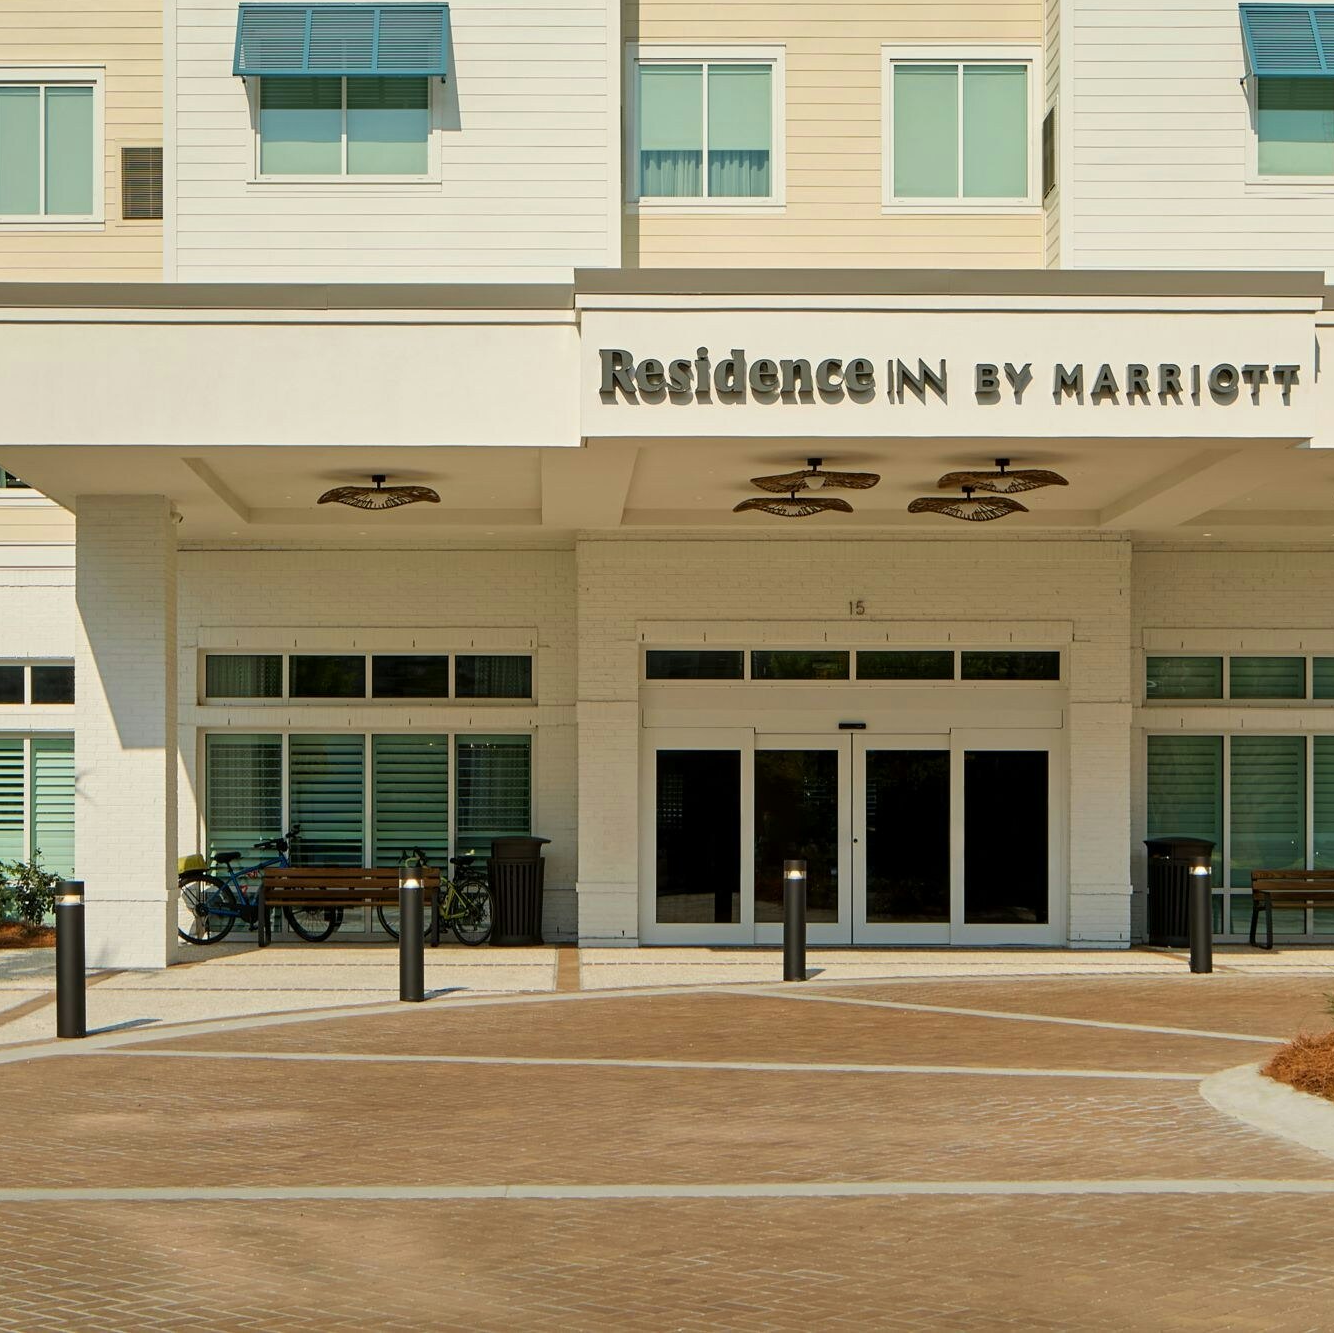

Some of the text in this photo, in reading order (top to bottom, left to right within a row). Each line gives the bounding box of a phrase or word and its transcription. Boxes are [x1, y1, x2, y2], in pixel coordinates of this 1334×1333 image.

[598, 346, 1301, 400] Residence INN BY MARRIOTT
[849, 600, 866, 615] 15
